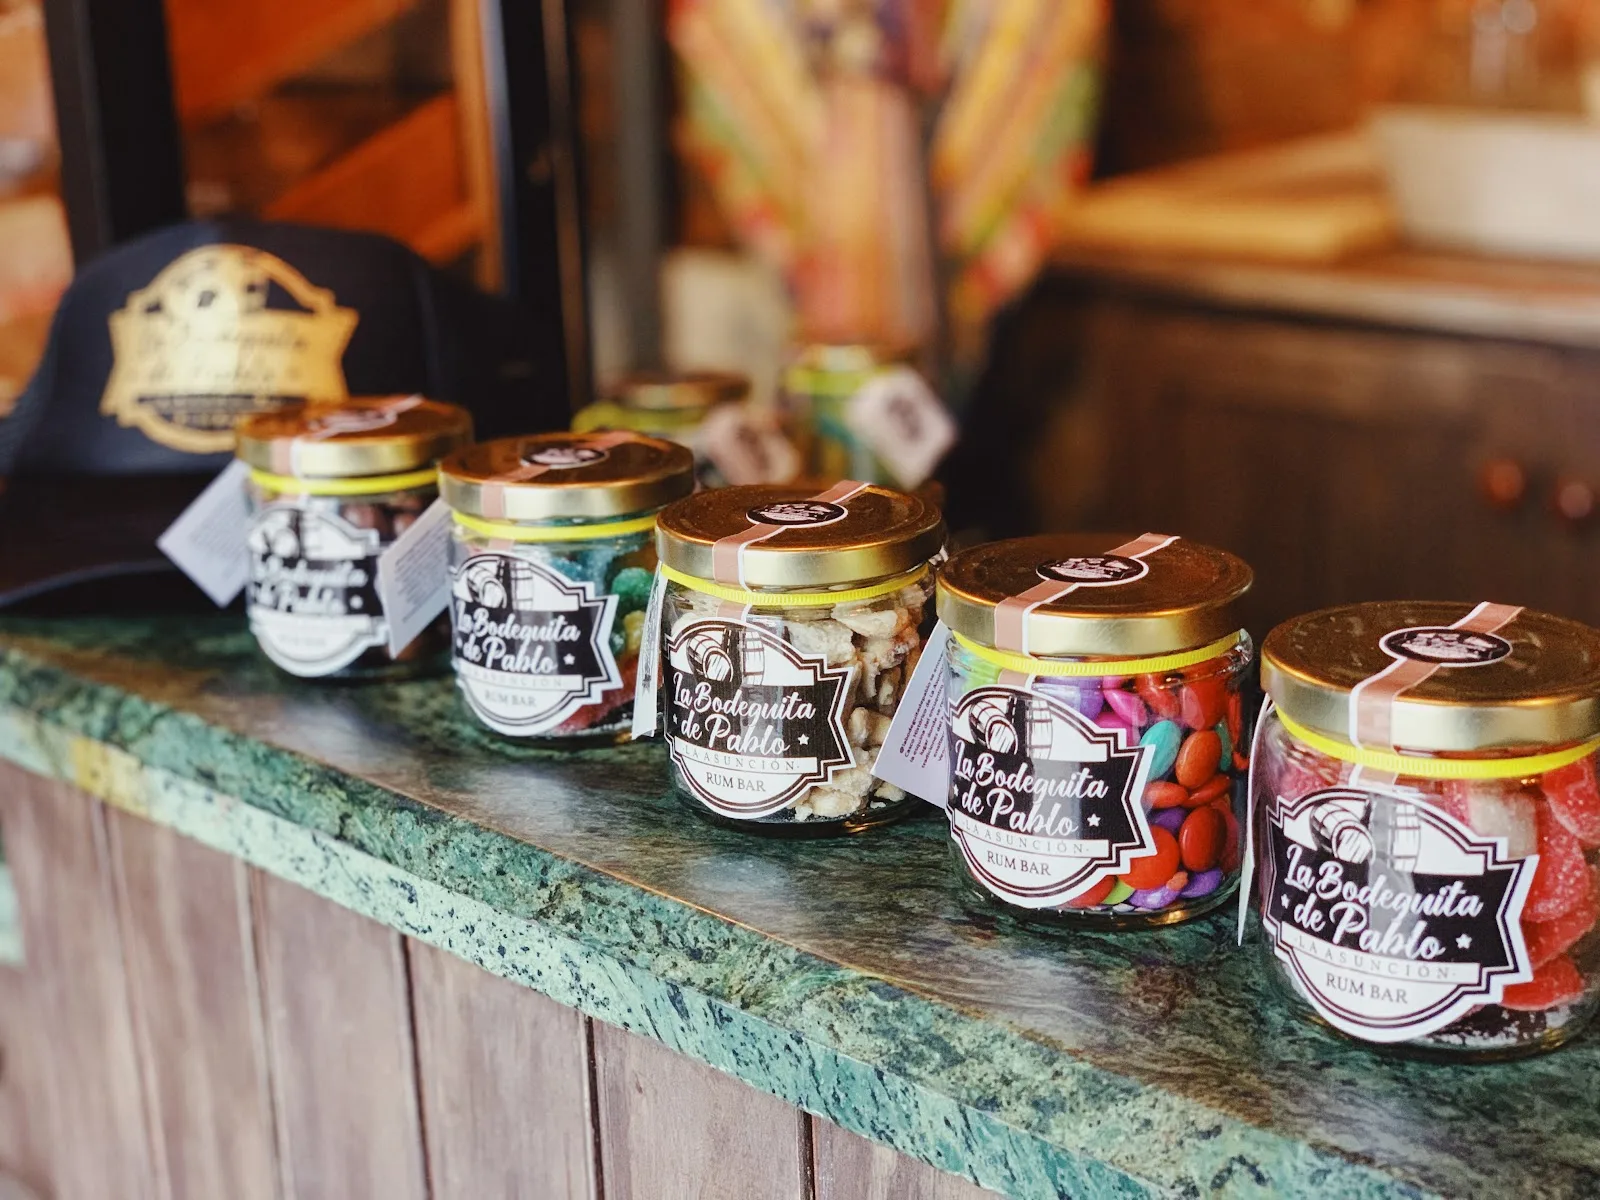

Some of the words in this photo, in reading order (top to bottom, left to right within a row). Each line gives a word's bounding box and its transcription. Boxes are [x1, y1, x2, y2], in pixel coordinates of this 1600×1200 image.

[473, 607, 581, 643] Bodeguita
[463, 633, 482, 662] de
[482, 636, 558, 674] Pablo
[673, 671, 693, 709] La
[693, 682, 816, 728] Bodeguita
[680, 710, 703, 740] de
[705, 713, 790, 755] Pablo
[703, 754, 796, 771] ASUNCIÓN
[955, 739, 975, 782] La
[975, 753, 1109, 803] Bodeguita
[706, 772, 733, 788] RUM
[738, 778, 766, 792] BAR
[961, 782, 984, 816] de
[987, 788, 1079, 836] Pablo
[984, 831, 1083, 854] ASUNCIÓN
[987, 850, 1016, 869] RUM
[1021, 861, 1051, 876] BAR
[1284, 844, 1315, 892] La
[1316, 860, 1484, 923] Bodeguita
[1294, 893, 1326, 932] de
[1329, 901, 1446, 960] Pablo
[1325, 950, 1450, 979] ASUNCIÓN
[1326, 973, 1365, 997] RUM
[1370, 986, 1408, 1004] BAR
